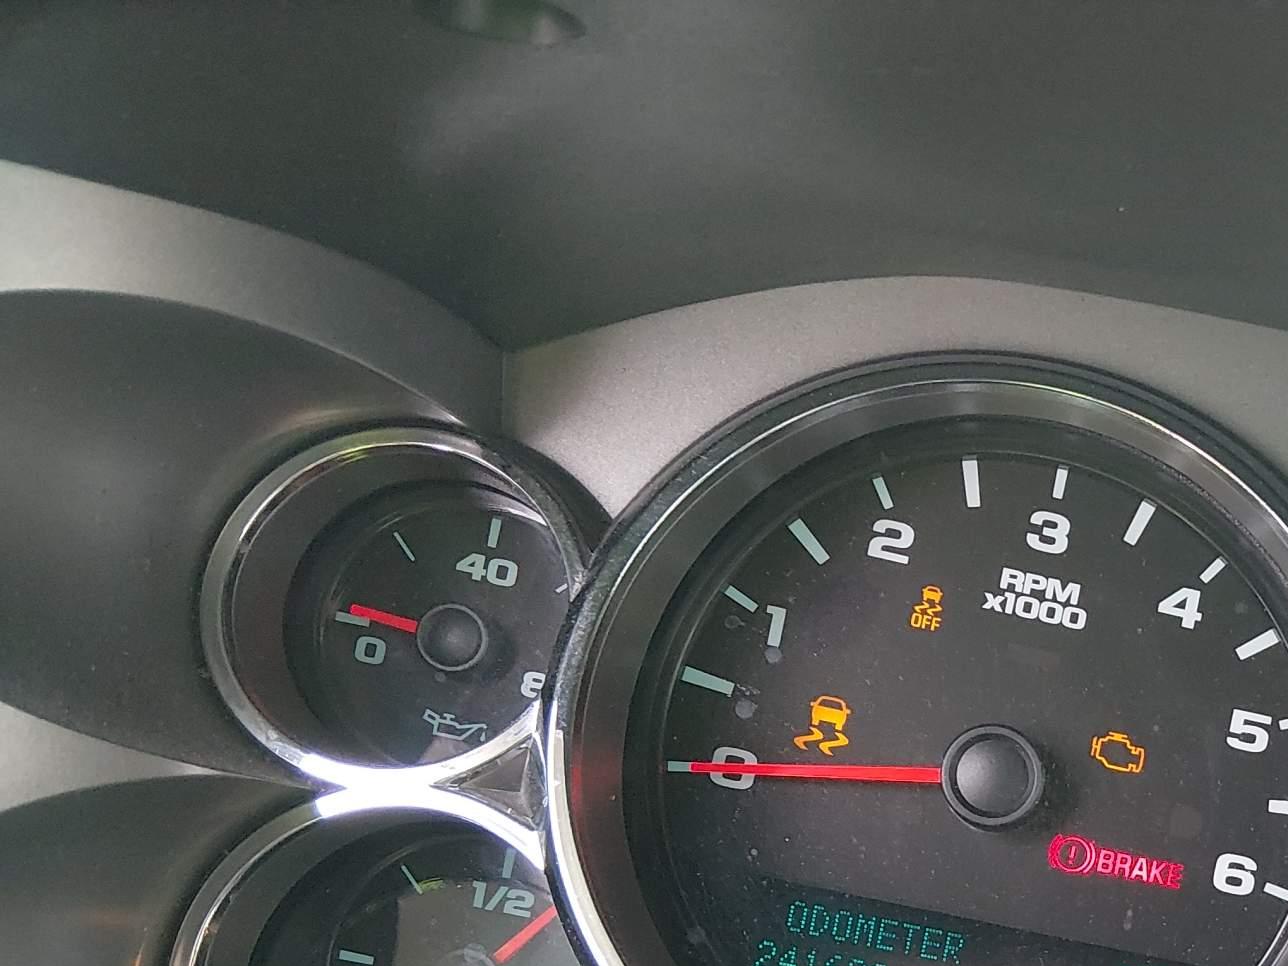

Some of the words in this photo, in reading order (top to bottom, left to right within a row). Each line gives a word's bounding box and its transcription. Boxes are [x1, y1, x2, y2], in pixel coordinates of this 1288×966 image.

[867, 518, 916, 564] 2
[1026, 510, 1071, 554] 3
[455, 553, 518, 587] 40
[999, 567, 1082, 606] RPM
[766, 604, 787, 648] 1
[909, 612, 943, 632] OFF
[982, 590, 1087, 631] x1000
[1157, 587, 1202, 629] 4
[354, 635, 386, 665] 0
[1226, 708, 1273, 753] 5
[708, 746, 758, 791] 0
[1096, 848, 1184, 889] BRAKE
[1212, 852, 1258, 896] 6
[471, 880, 535, 918] 1/2
[786, 900, 966, 965] ODOMETER
